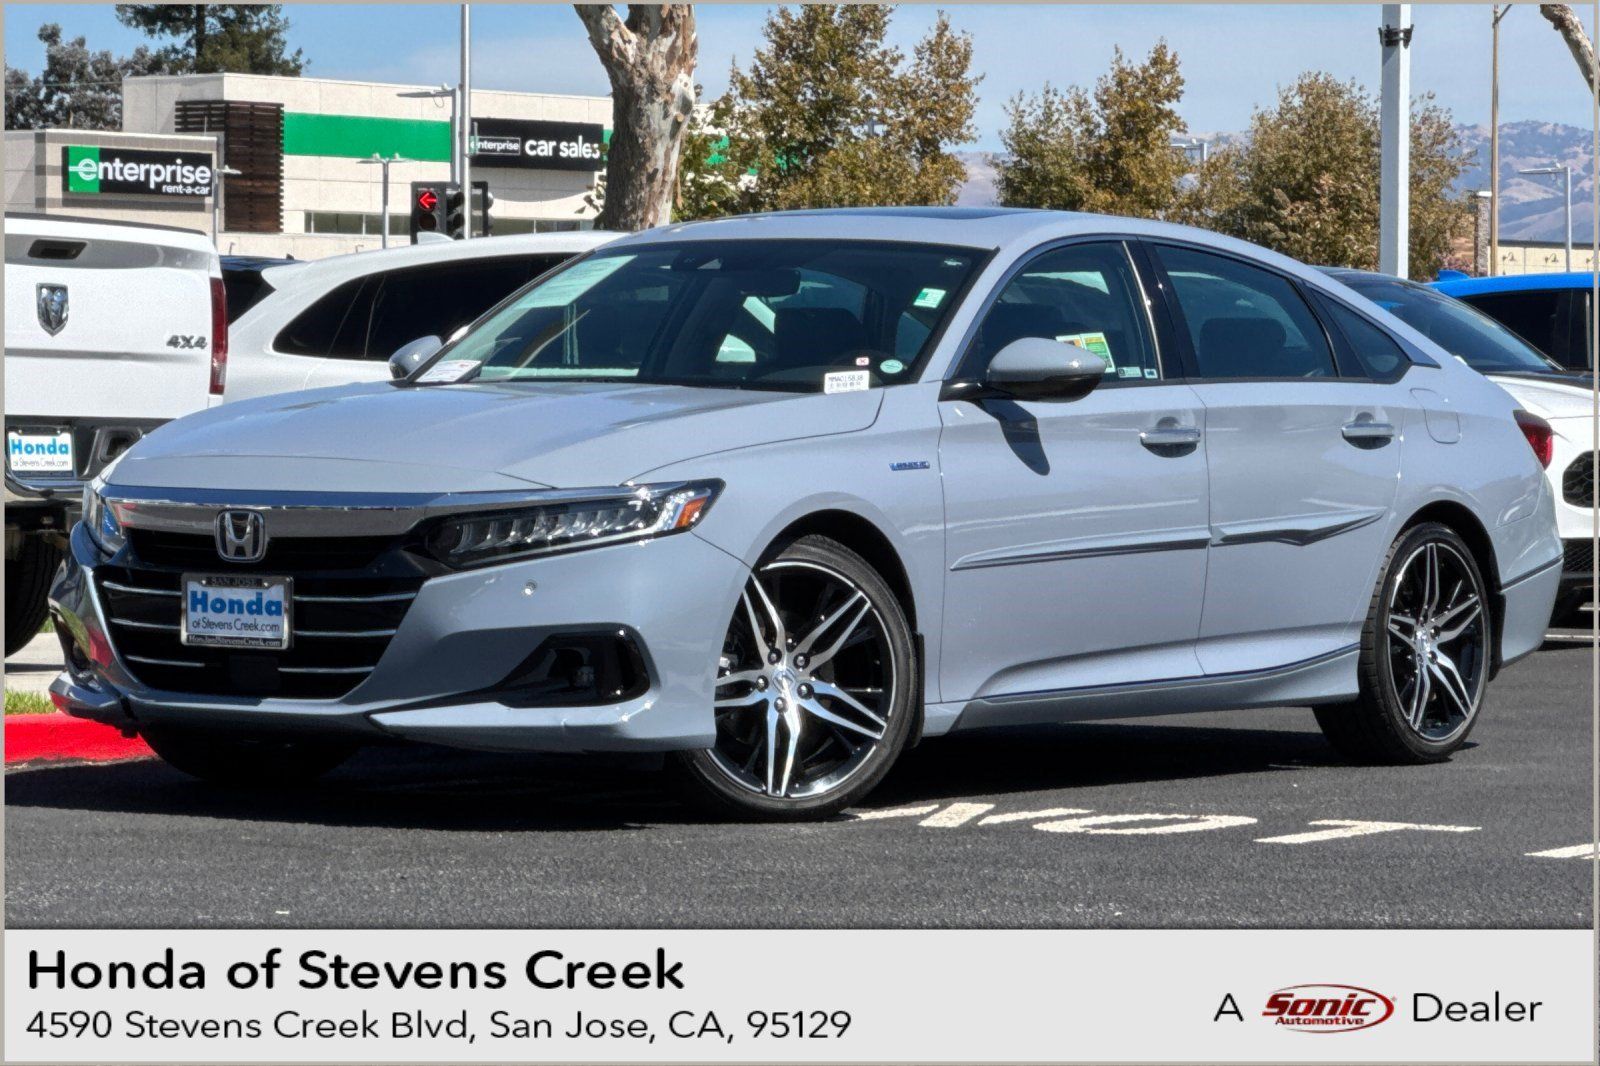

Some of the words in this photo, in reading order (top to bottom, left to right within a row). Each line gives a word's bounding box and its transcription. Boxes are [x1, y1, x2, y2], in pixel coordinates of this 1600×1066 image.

[470, 140, 520, 151] enterprise
[525, 139, 557, 157] car
[559, 135, 600, 159] sales
[70, 158, 211, 189] enterprise
[162, 184, 210, 195] rent-a-car
[10, 437, 69, 455] Honda
[190, 590, 283, 617] Honda
[192, 618, 201, 628] of
[202, 616, 233, 631] Stevens
[234, 617, 280, 632] Creek.com
